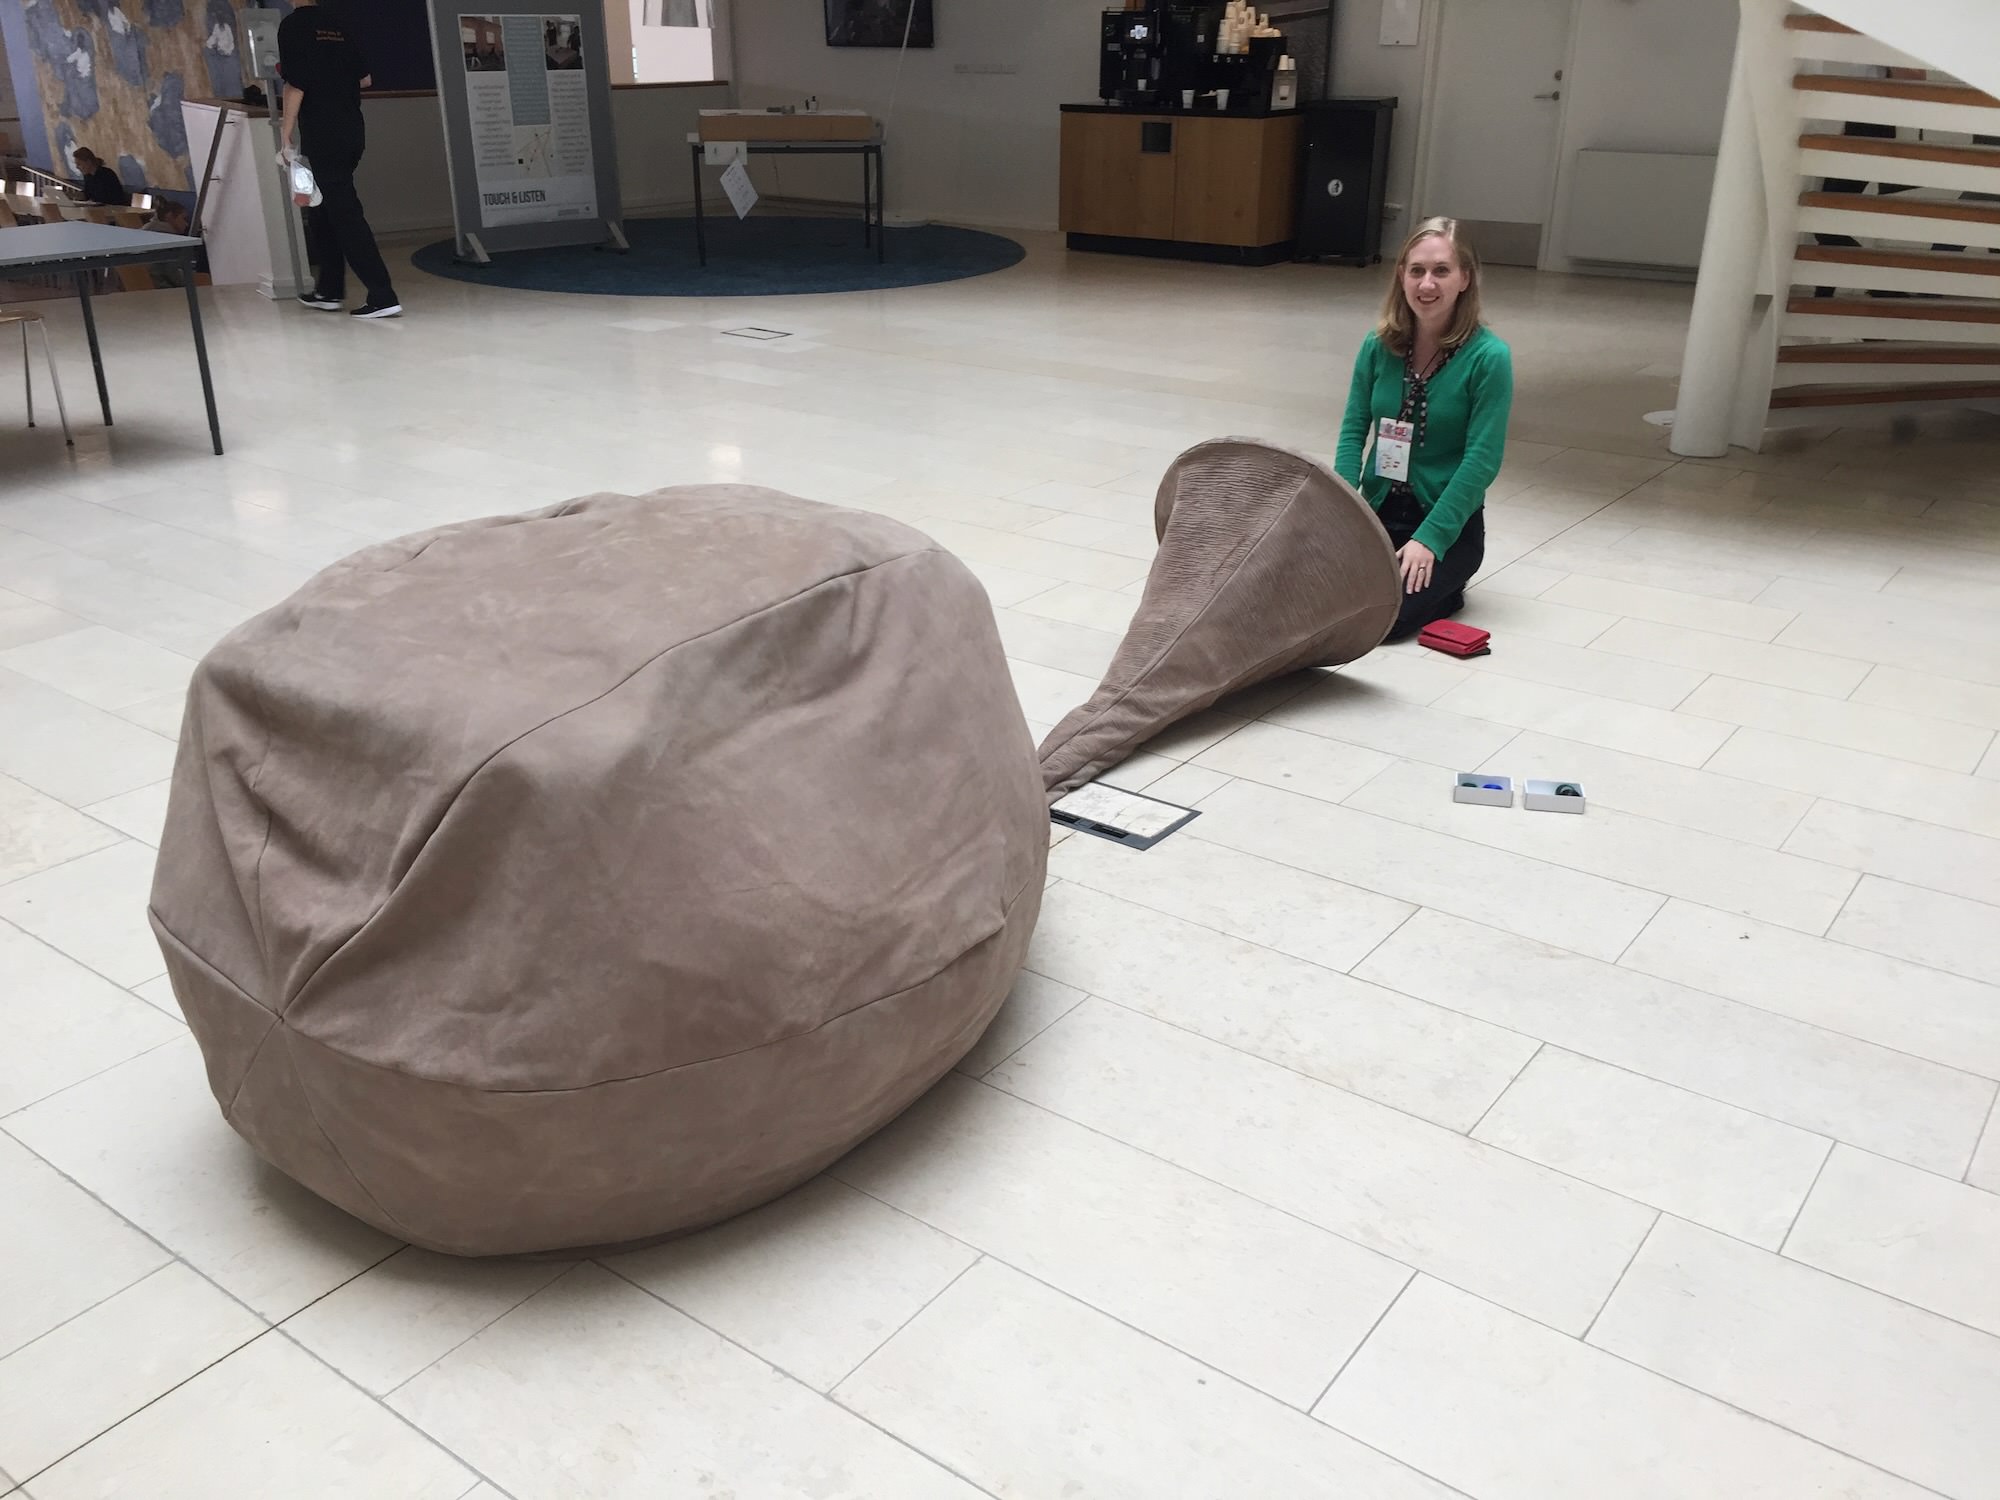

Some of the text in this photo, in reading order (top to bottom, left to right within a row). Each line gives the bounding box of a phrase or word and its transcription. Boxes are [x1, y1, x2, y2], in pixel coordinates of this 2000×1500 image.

[483, 190, 546, 205] TOUCH & LISTEN
